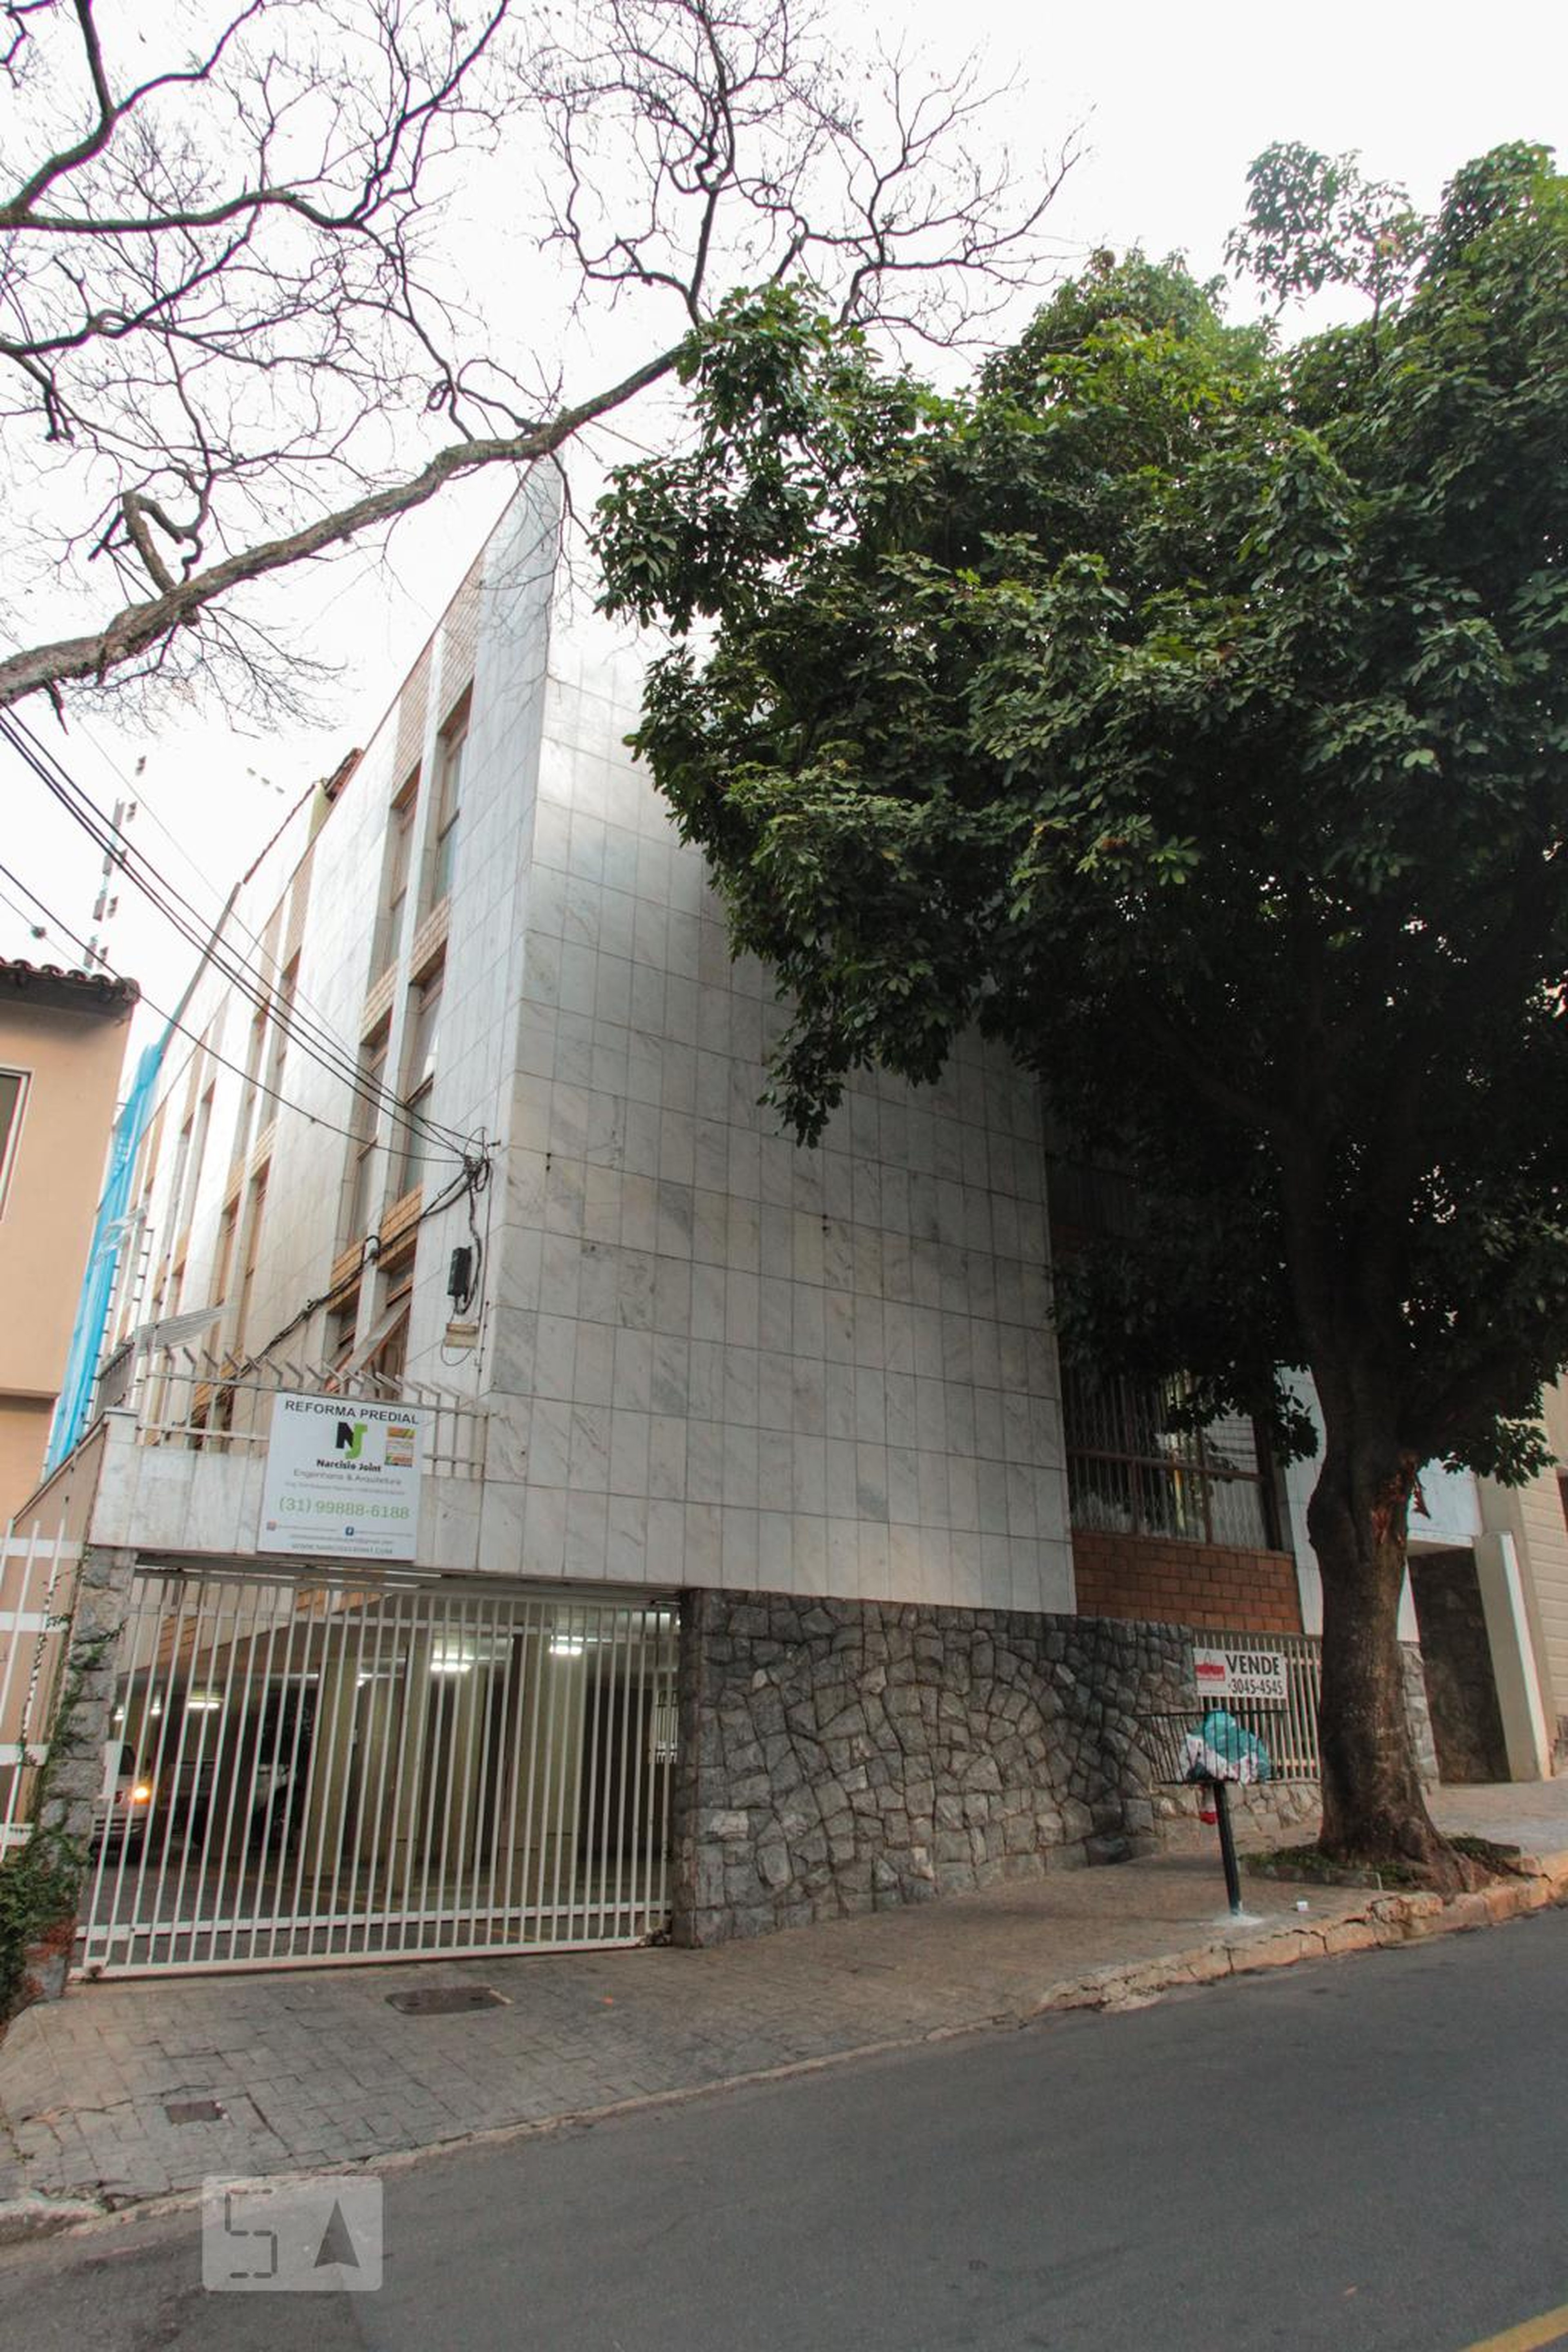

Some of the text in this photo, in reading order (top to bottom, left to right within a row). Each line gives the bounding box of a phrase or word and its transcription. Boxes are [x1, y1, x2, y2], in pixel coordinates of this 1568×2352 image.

[285, 1400, 419, 1425] REFORMA PREDIAL
[359, 1462, 381, 1472] Joint
[279, 1496, 311, 1513] (31)
[1225, 1654, 1280, 1675] VENDE
